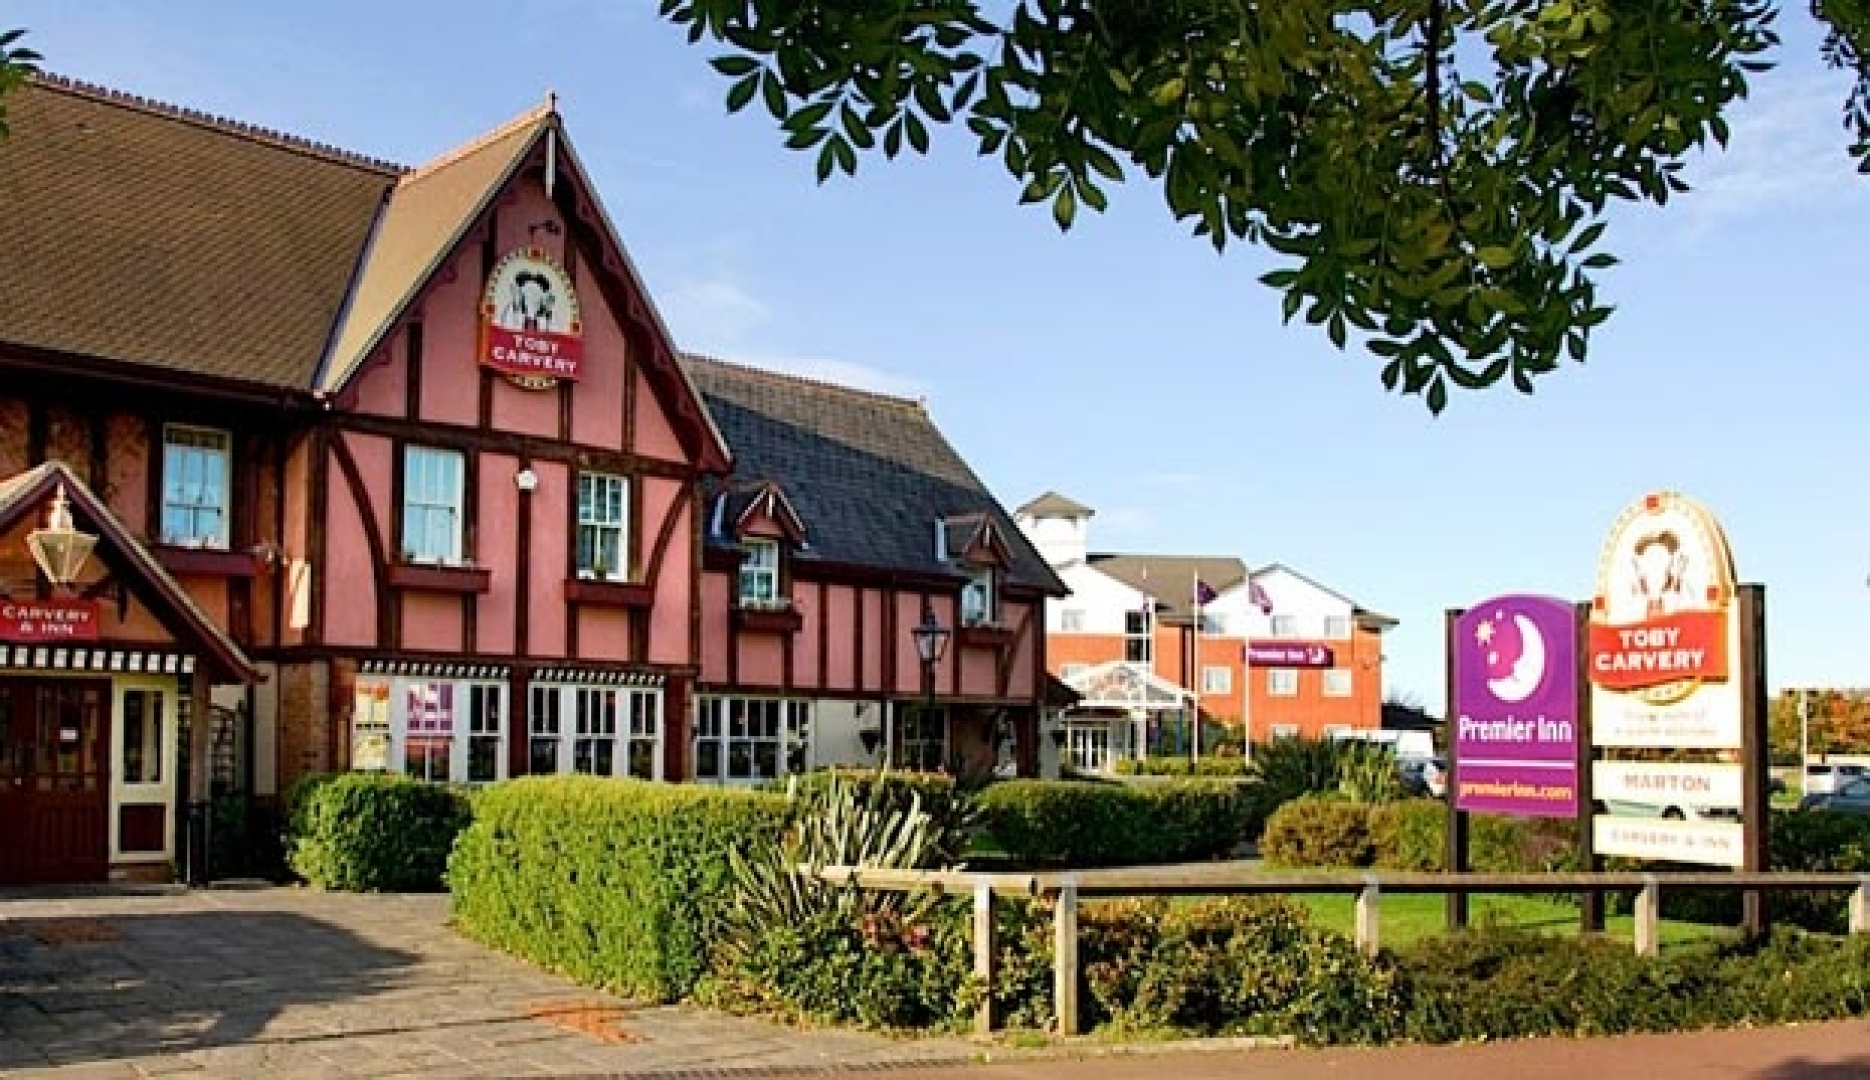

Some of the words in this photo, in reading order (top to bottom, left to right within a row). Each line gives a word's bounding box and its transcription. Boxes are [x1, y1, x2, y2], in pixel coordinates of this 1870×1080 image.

[513, 335, 560, 355] TOBY
[492, 346, 577, 371] CARVERY
[2, 604, 90, 622] CARVERY
[42, 622, 74, 636] INN
[1619, 627, 1681, 648] TOBY
[1595, 649, 1706, 672] CARVERY
[1459, 714, 1535, 742] Premier
[1538, 714, 1572, 742] Inn
[1459, 779, 1572, 801] premierinn.com
[1623, 773, 1711, 792] MARTON
